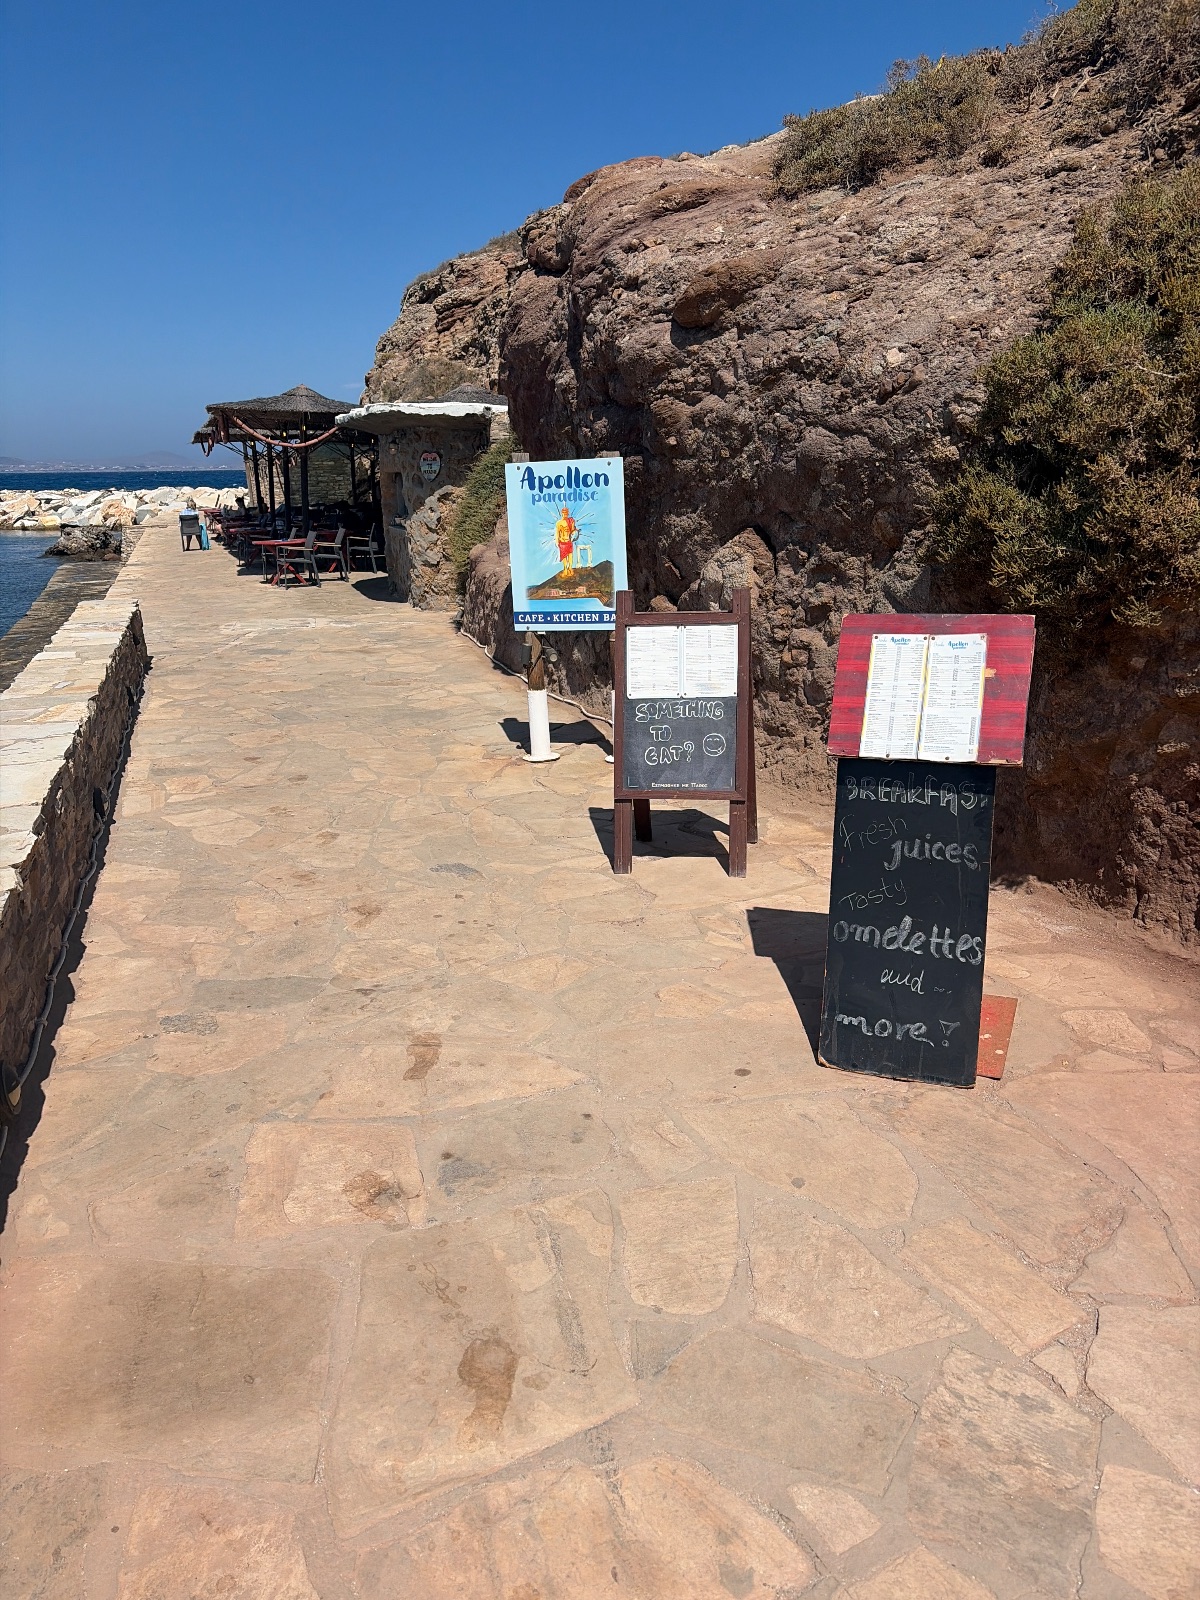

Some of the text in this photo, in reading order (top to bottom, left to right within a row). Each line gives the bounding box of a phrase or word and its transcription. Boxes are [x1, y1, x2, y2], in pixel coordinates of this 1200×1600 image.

[520, 466, 609, 494] Apollon
[531, 488, 599, 505] paradise
[518, 612, 616, 622] CAFE KITCHEN BA
[636, 701, 724, 722] SOMETHING
[650, 725, 672, 742] TO
[645, 741, 694, 765] EAT?
[833, 915, 983, 966] omelettes
